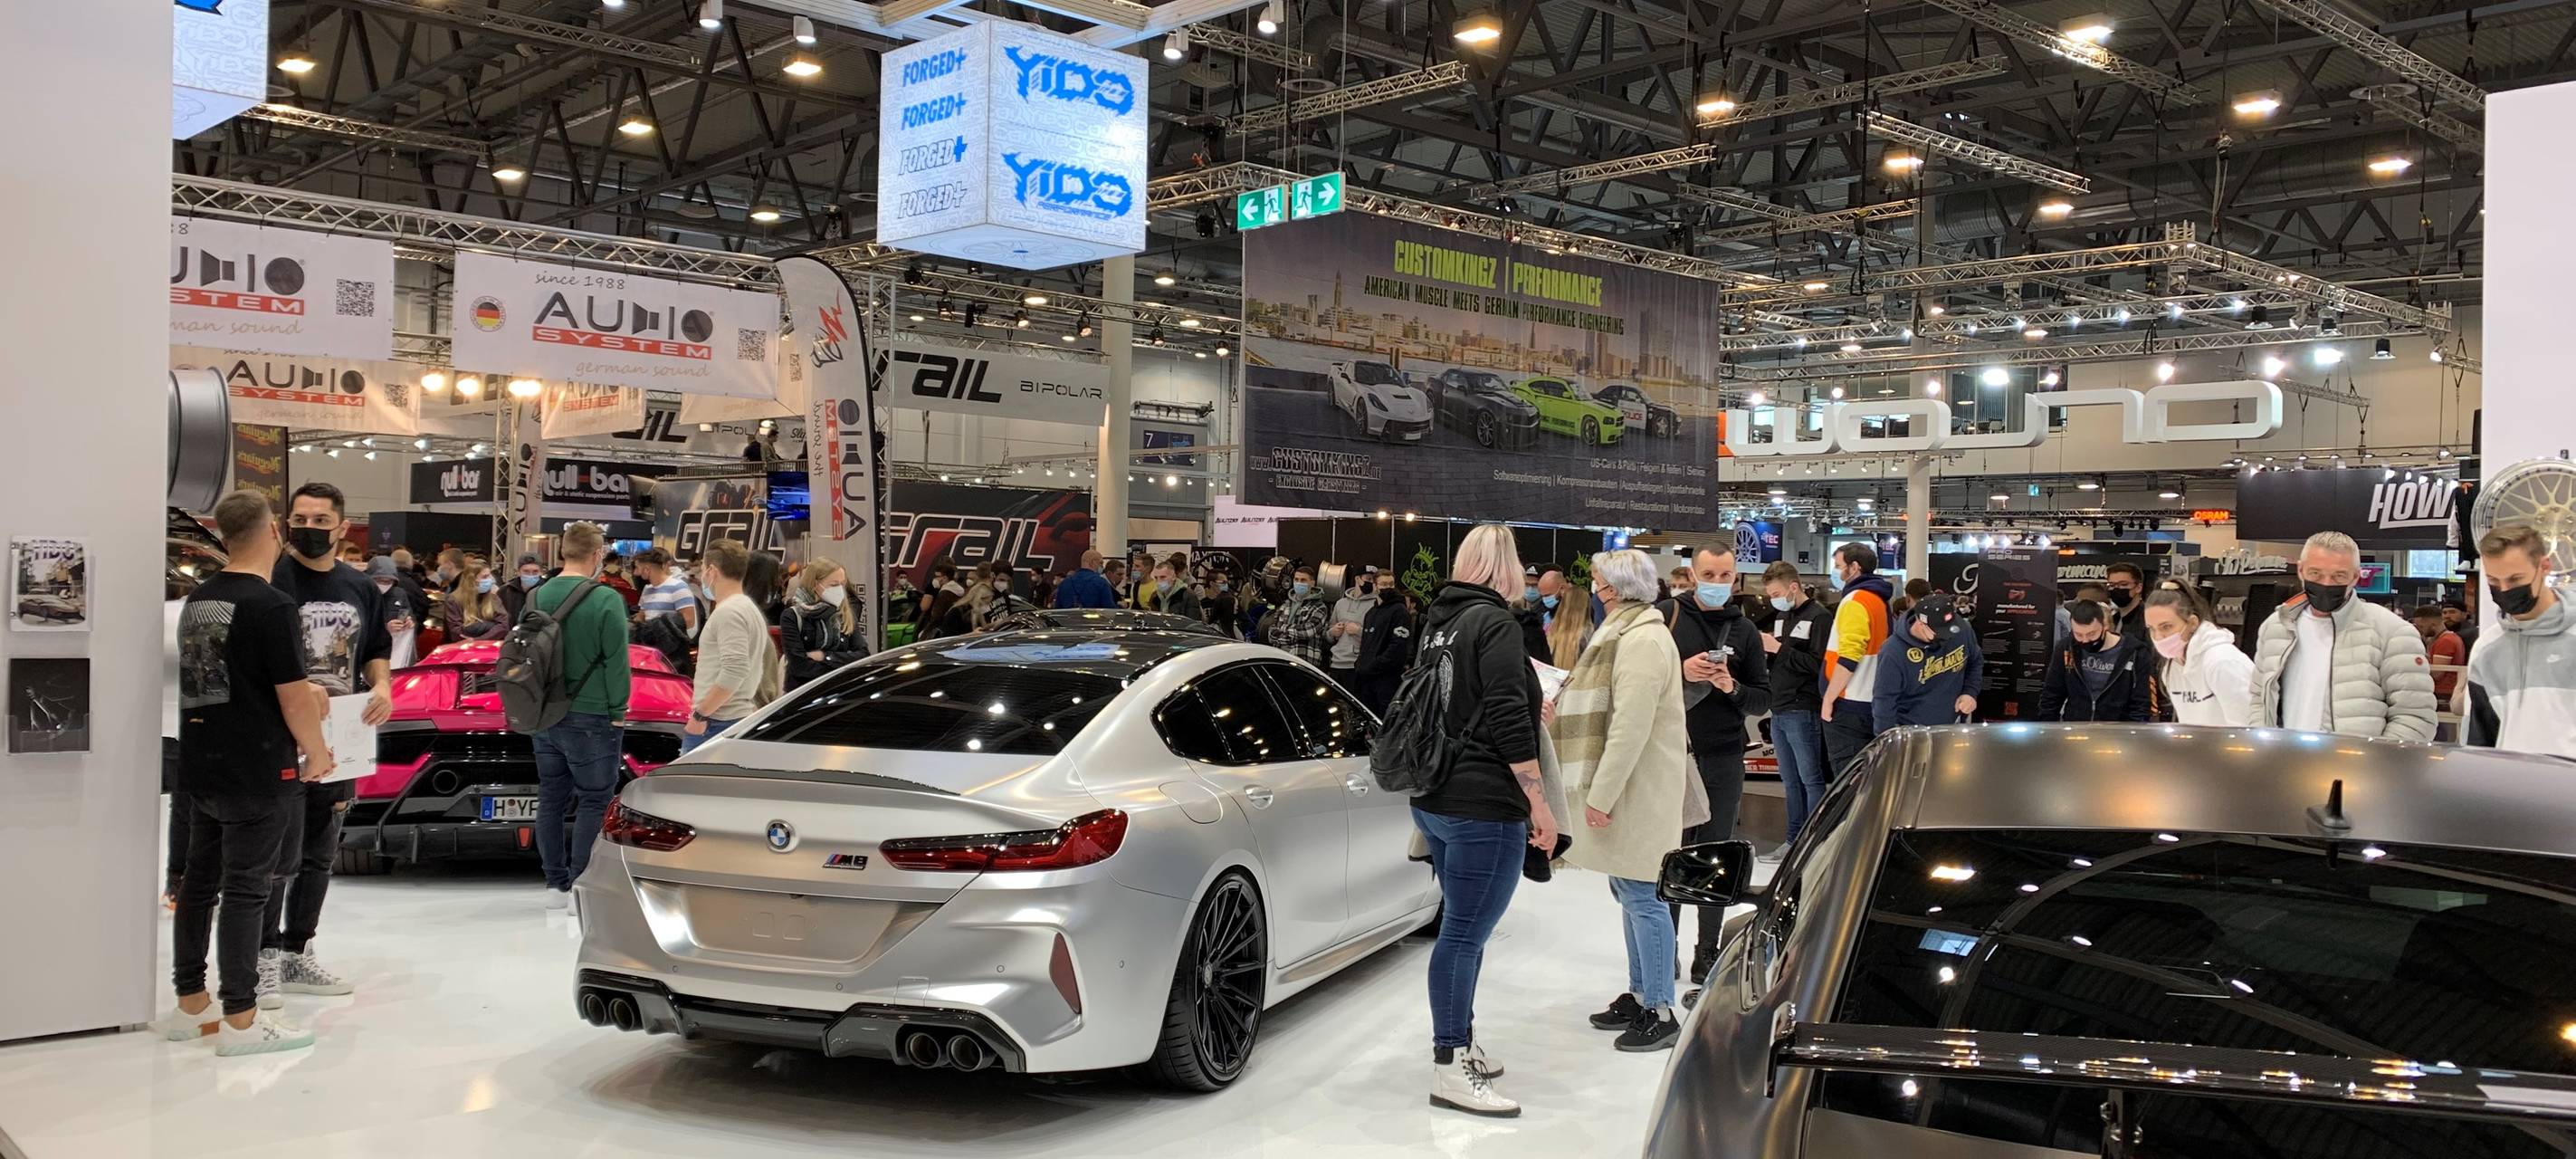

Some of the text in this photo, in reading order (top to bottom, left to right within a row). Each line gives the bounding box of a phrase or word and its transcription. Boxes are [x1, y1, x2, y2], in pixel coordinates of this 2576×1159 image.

[902, 47, 967, 87] FORGED+
[902, 92, 967, 130] FORGED+
[899, 136, 968, 175] FORGED+
[898, 181, 968, 219] FORGED+
[535, 271, 625, 290] since 1988
[1394, 240, 1602, 307] CUSTOMKINGZ PERFORMANCE
[1364, 275, 1409, 302] AMERICAN
[1415, 283, 1448, 308] MUSCLE
[1453, 291, 1479, 312] MEETS
[1484, 296, 1519, 319] GERMAN
[536, 329, 710, 359] SYSTEM
[575, 361, 712, 378] german sound
[1020, 380, 1102, 399] BIPOLAR
[1145, 433, 1153, 447] 7
[2194, 510, 2228, 521] OSRAM
[494, 800, 505, 816] H
